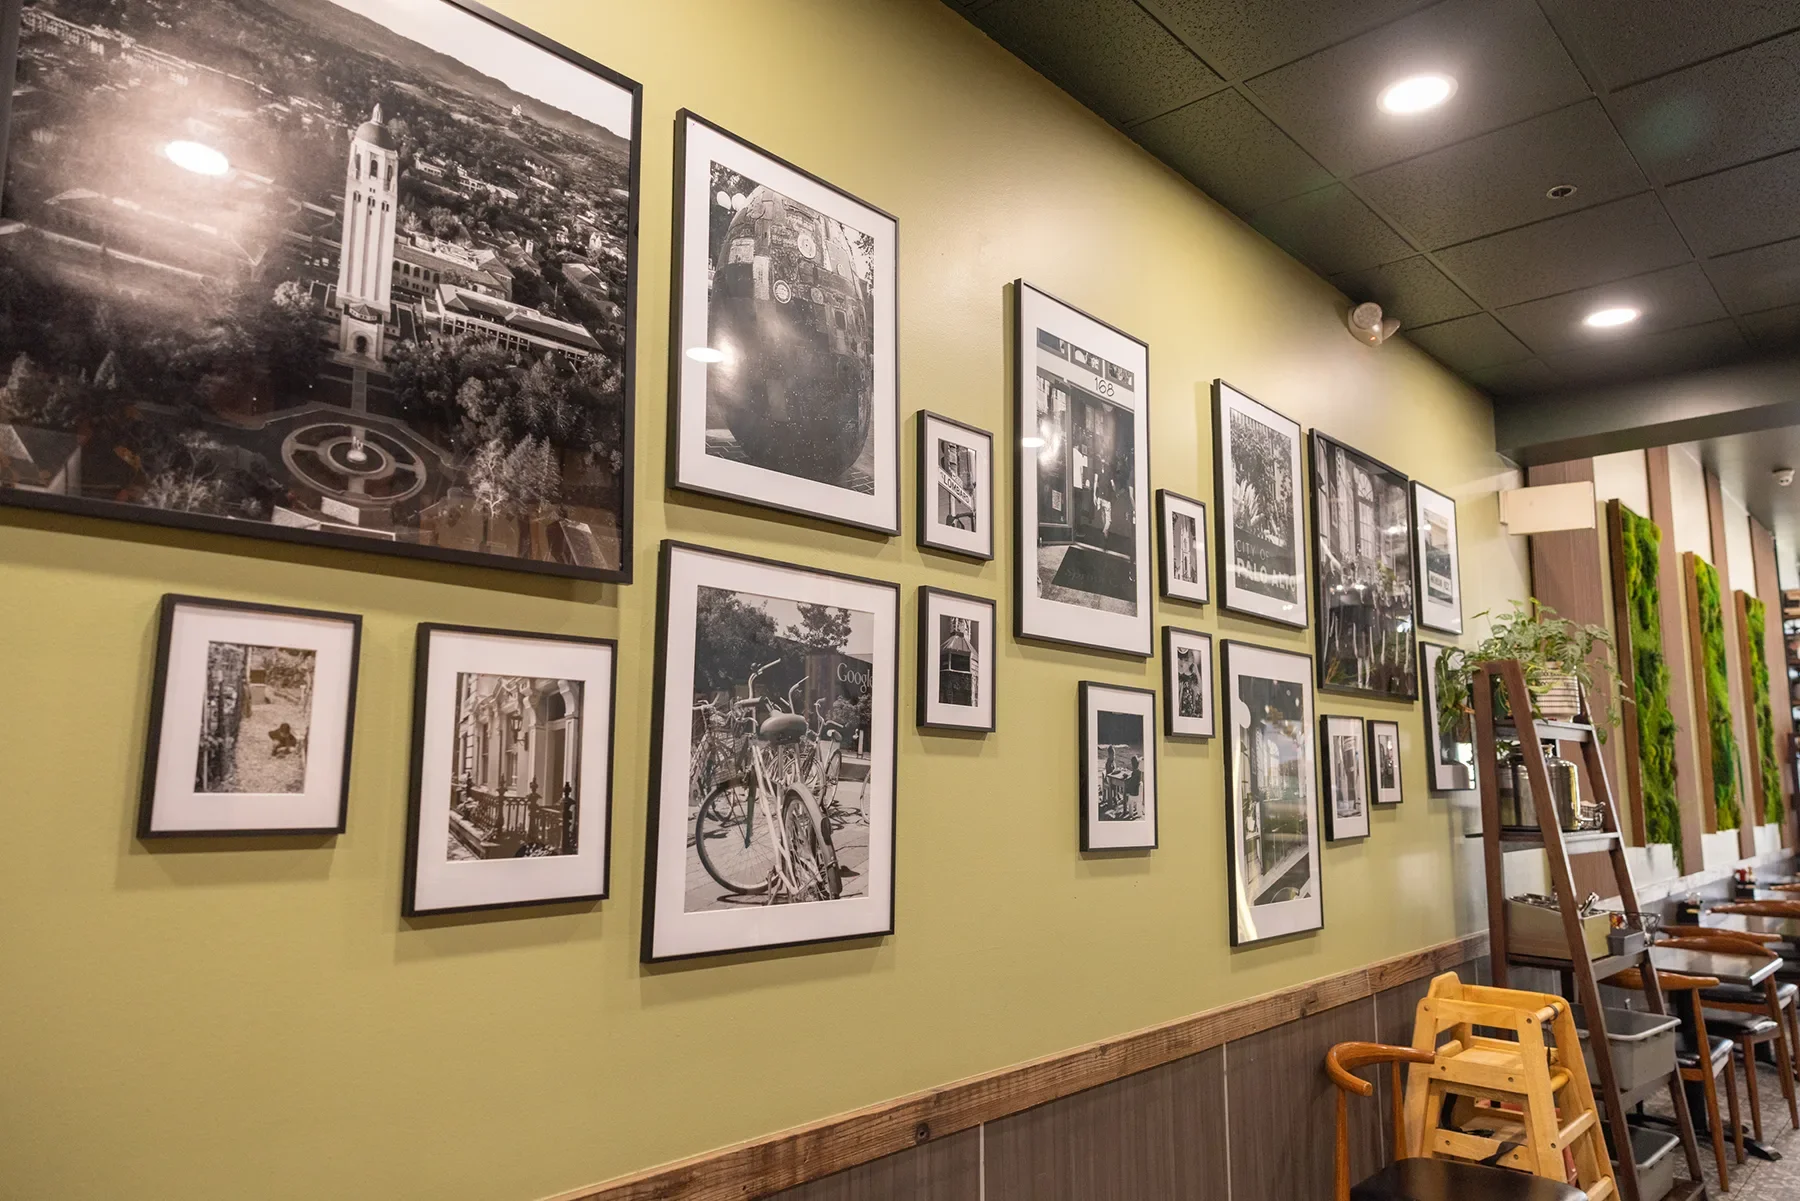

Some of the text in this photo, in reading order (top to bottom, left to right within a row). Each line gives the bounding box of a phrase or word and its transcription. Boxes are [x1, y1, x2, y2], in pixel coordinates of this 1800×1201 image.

[1094, 377, 1115, 397] 168
[943, 473, 970, 504] LOMBARD
[1235, 539, 1256, 557] CITY
[1236, 557, 1296, 592] PALO ALTO
